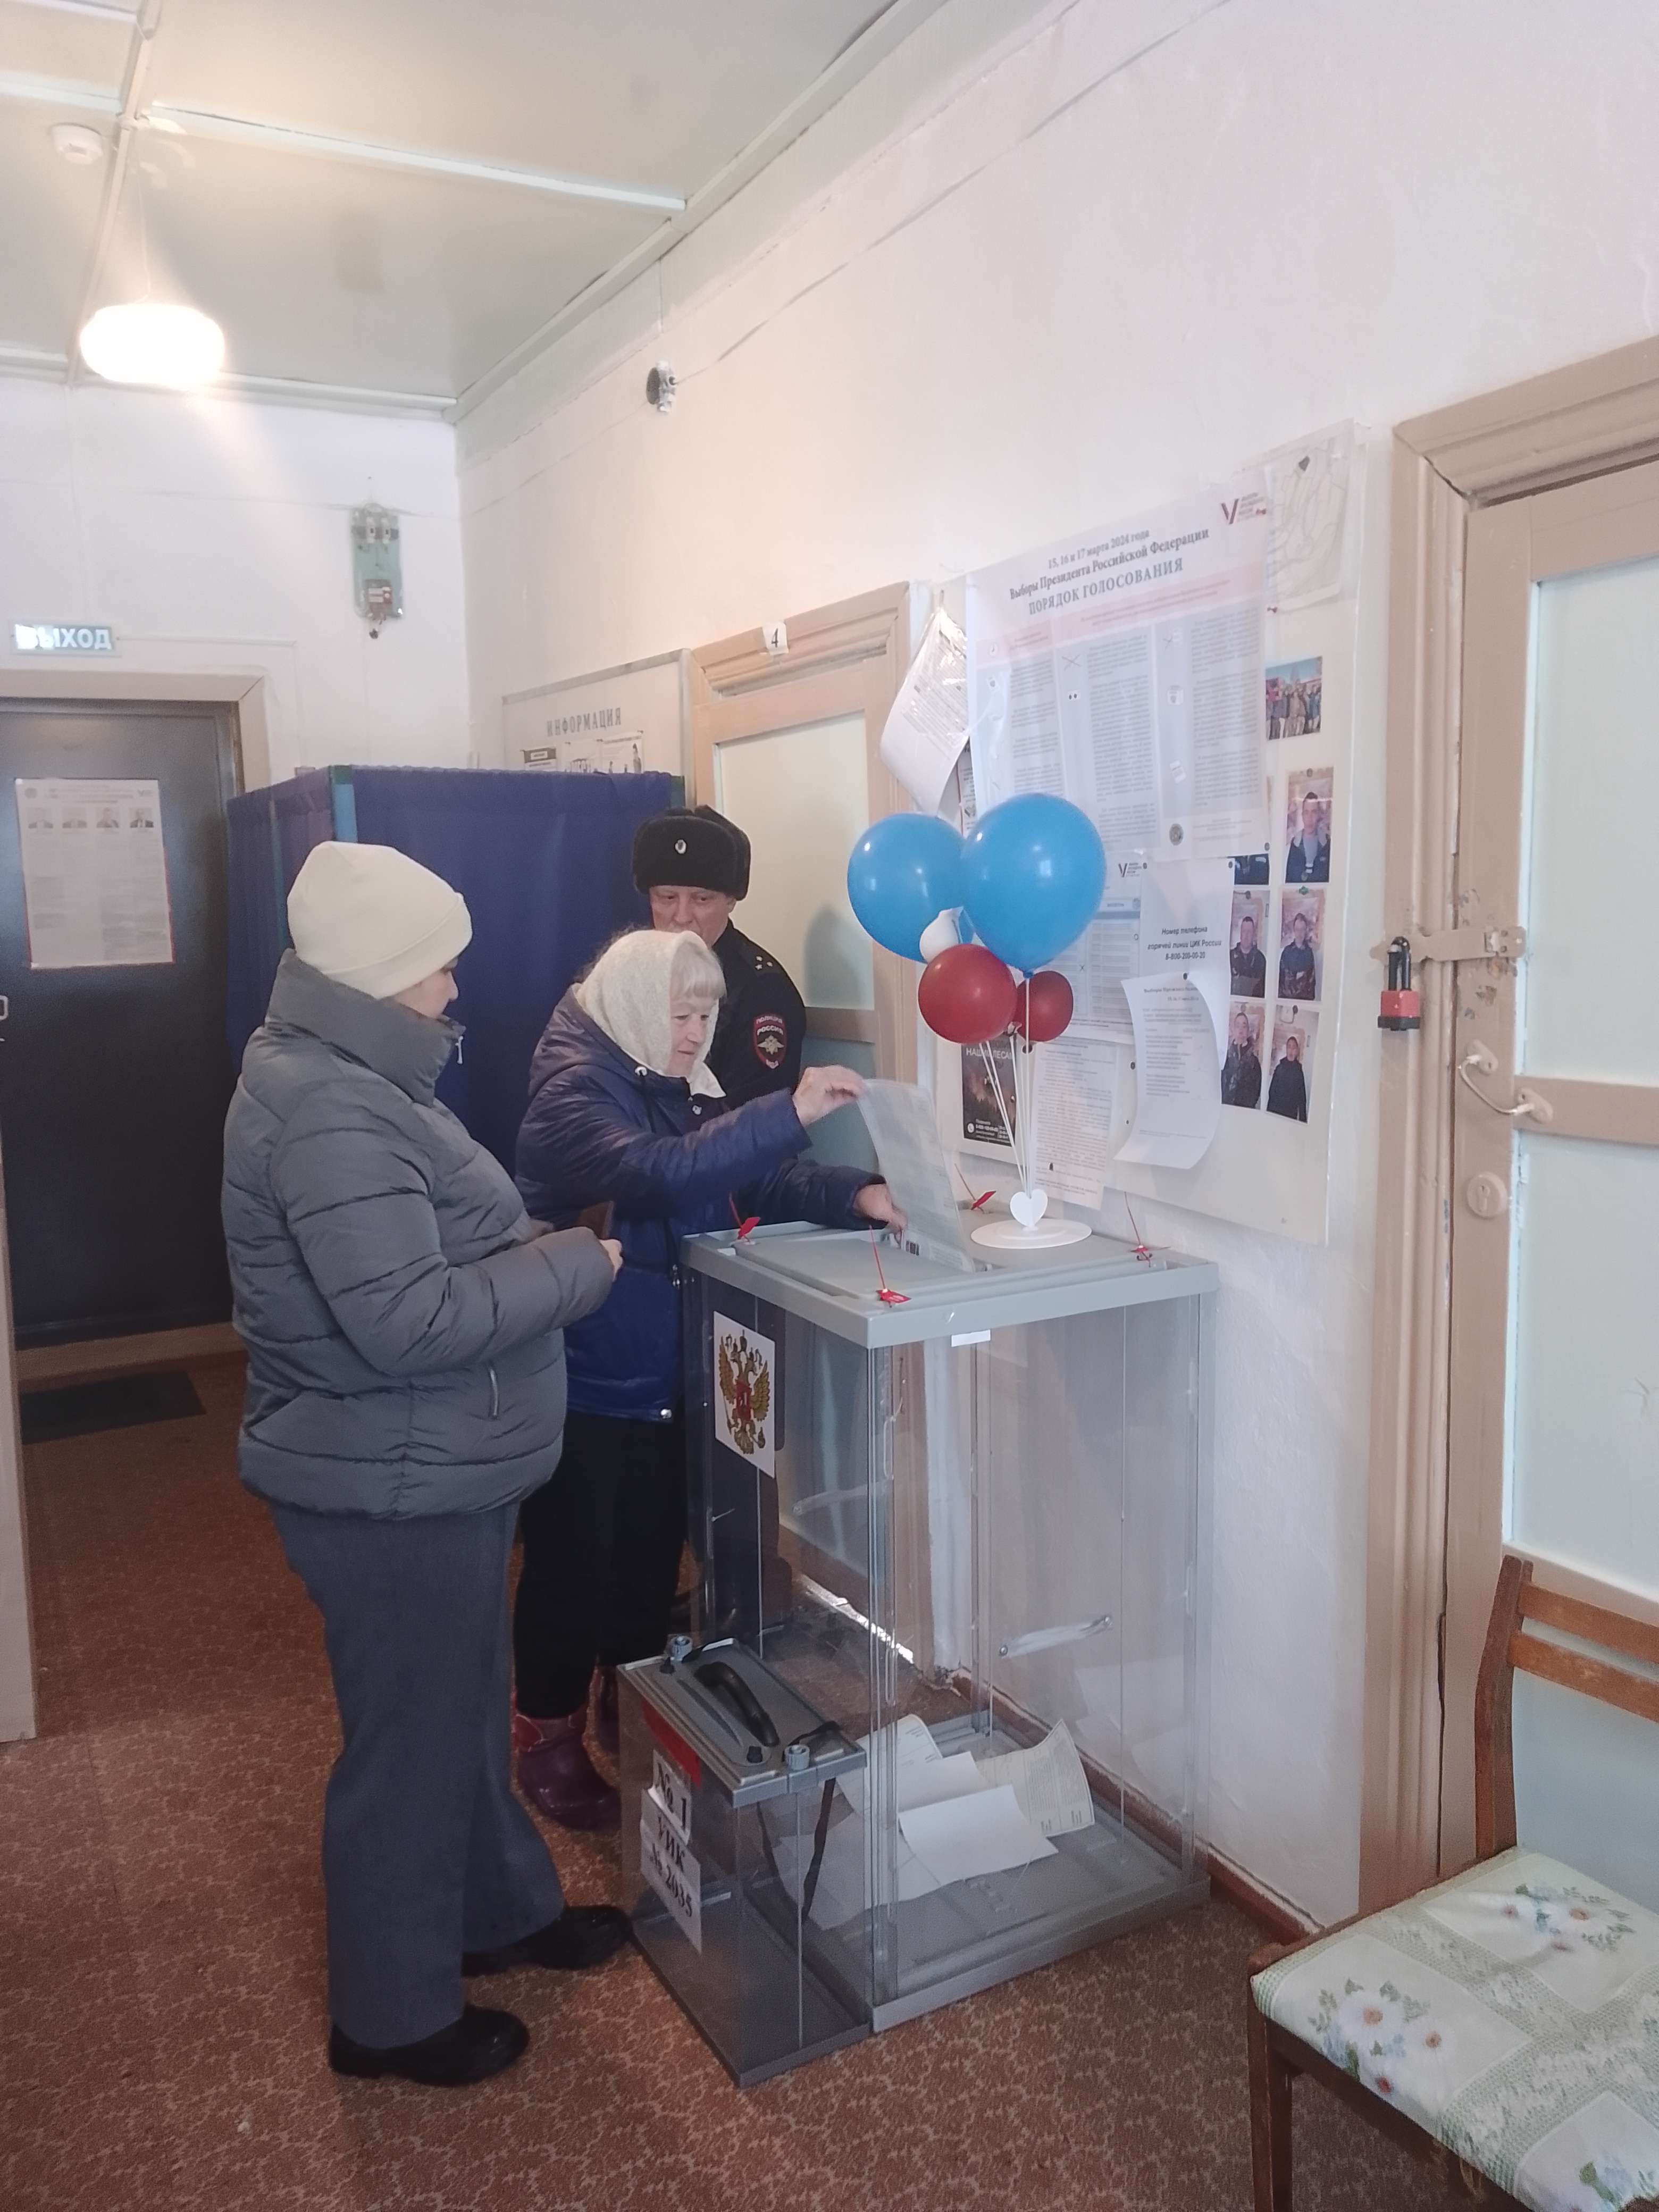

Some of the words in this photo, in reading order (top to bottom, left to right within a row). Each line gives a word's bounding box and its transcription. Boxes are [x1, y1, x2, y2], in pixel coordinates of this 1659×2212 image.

[1049, 559, 1058, 569] 15,
[1061, 556, 1069, 566] 16
[1077, 551, 1084, 561] 17
[1086, 542, 1109, 557] марта
[1110, 533, 1129, 548] 2024
[1131, 530, 1150, 542] года
[1010, 581, 1038, 600] Выборы
[1040, 565, 1091, 590] Президента
[1092, 544, 1147, 572] Российской
[1150, 529, 1209, 554] Федерации
[1029, 587, 1080, 615] ПОРЯДОК
[1083, 558, 1183, 599] ГОЛОСОВАНИЯ
[15, 624, 112, 650] ВЫХОД
[771, 627, 778, 648] 4
[547, 707, 621, 737] ИНФОРМАЦИЯ
[1180, 926, 1208, 935] телефона
[1147, 942, 1171, 951] горячей
[757, 1025, 783, 1036] РОССИЯ
[966, 1048, 991, 1057] НАШИ
[656, 1762, 674, 1814] №
[681, 1798, 687, 1833] 1
[665, 1864, 693, 1917] 2035
